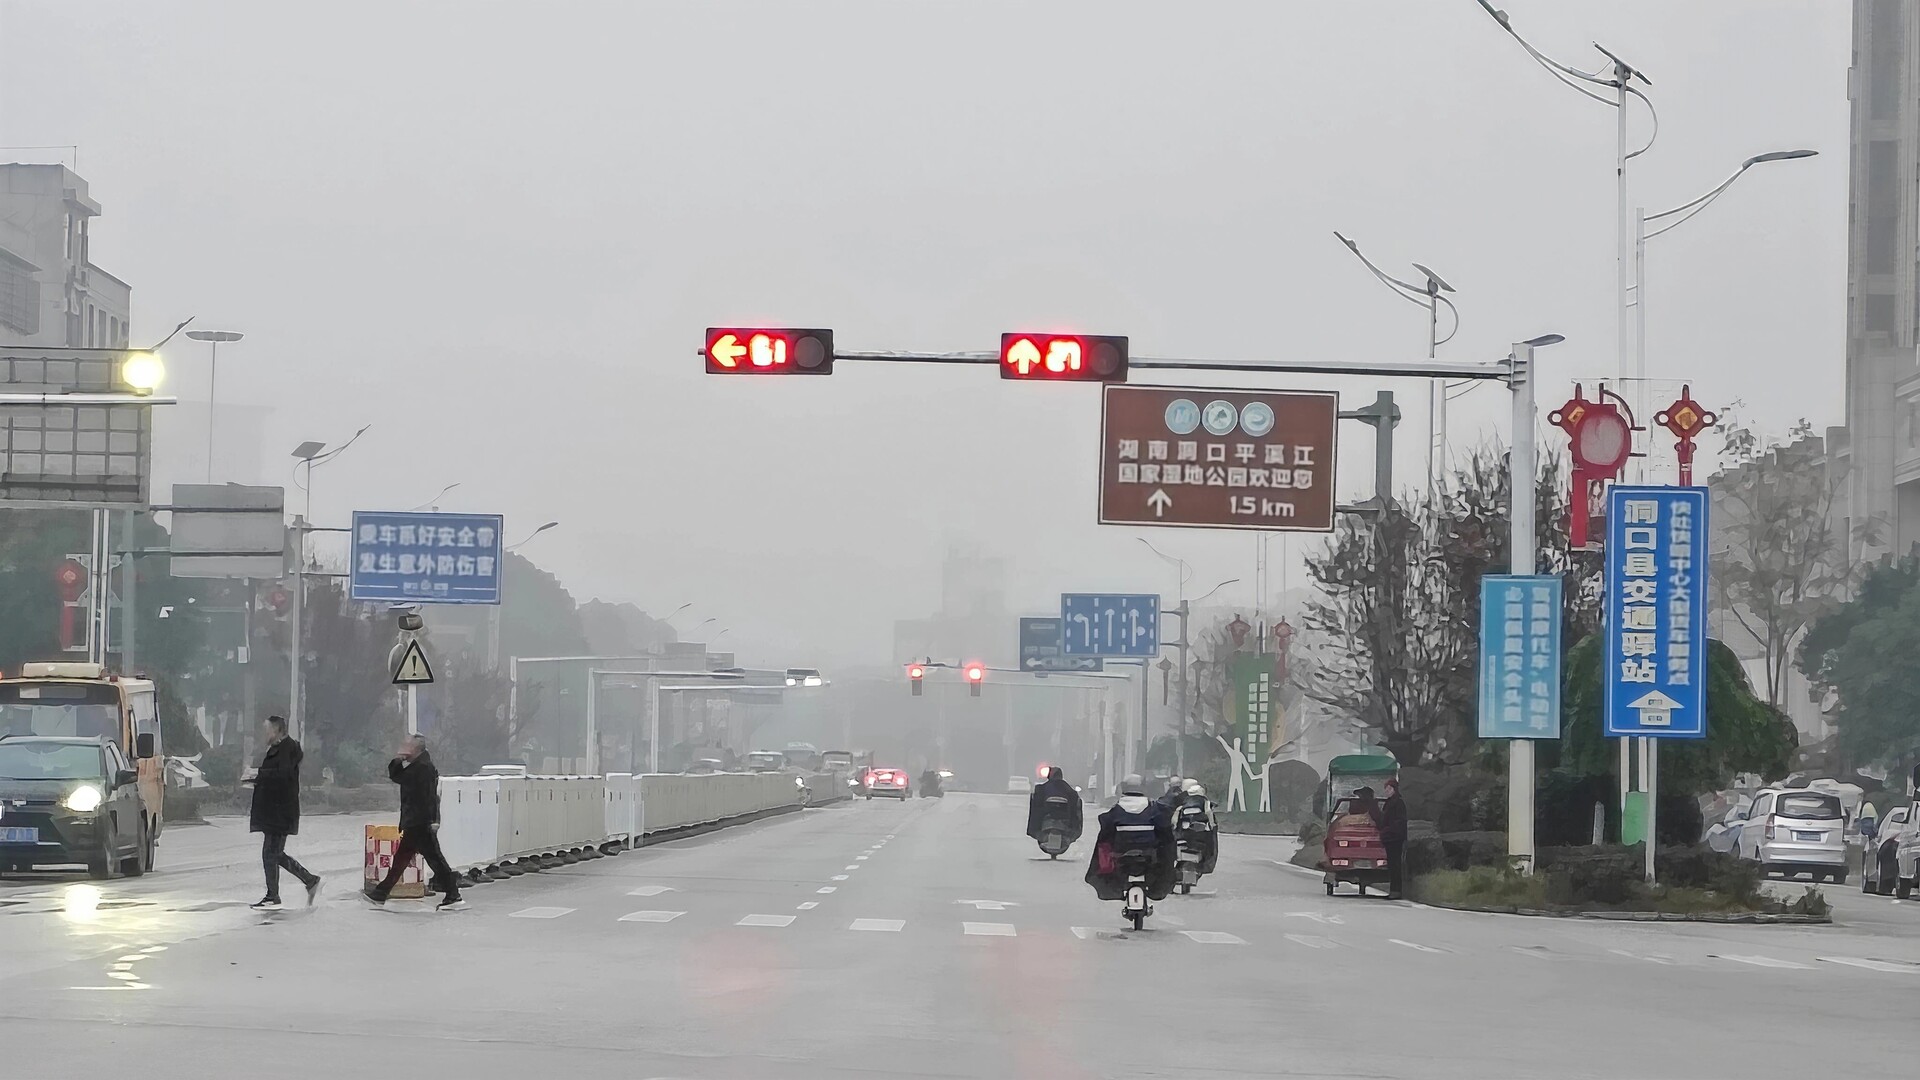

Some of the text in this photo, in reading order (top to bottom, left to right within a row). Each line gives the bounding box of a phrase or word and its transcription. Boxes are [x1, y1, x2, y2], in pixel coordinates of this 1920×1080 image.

[1118, 463, 1313, 489] 国家湿地公园欢迎您
[1261, 498, 1295, 517] km
